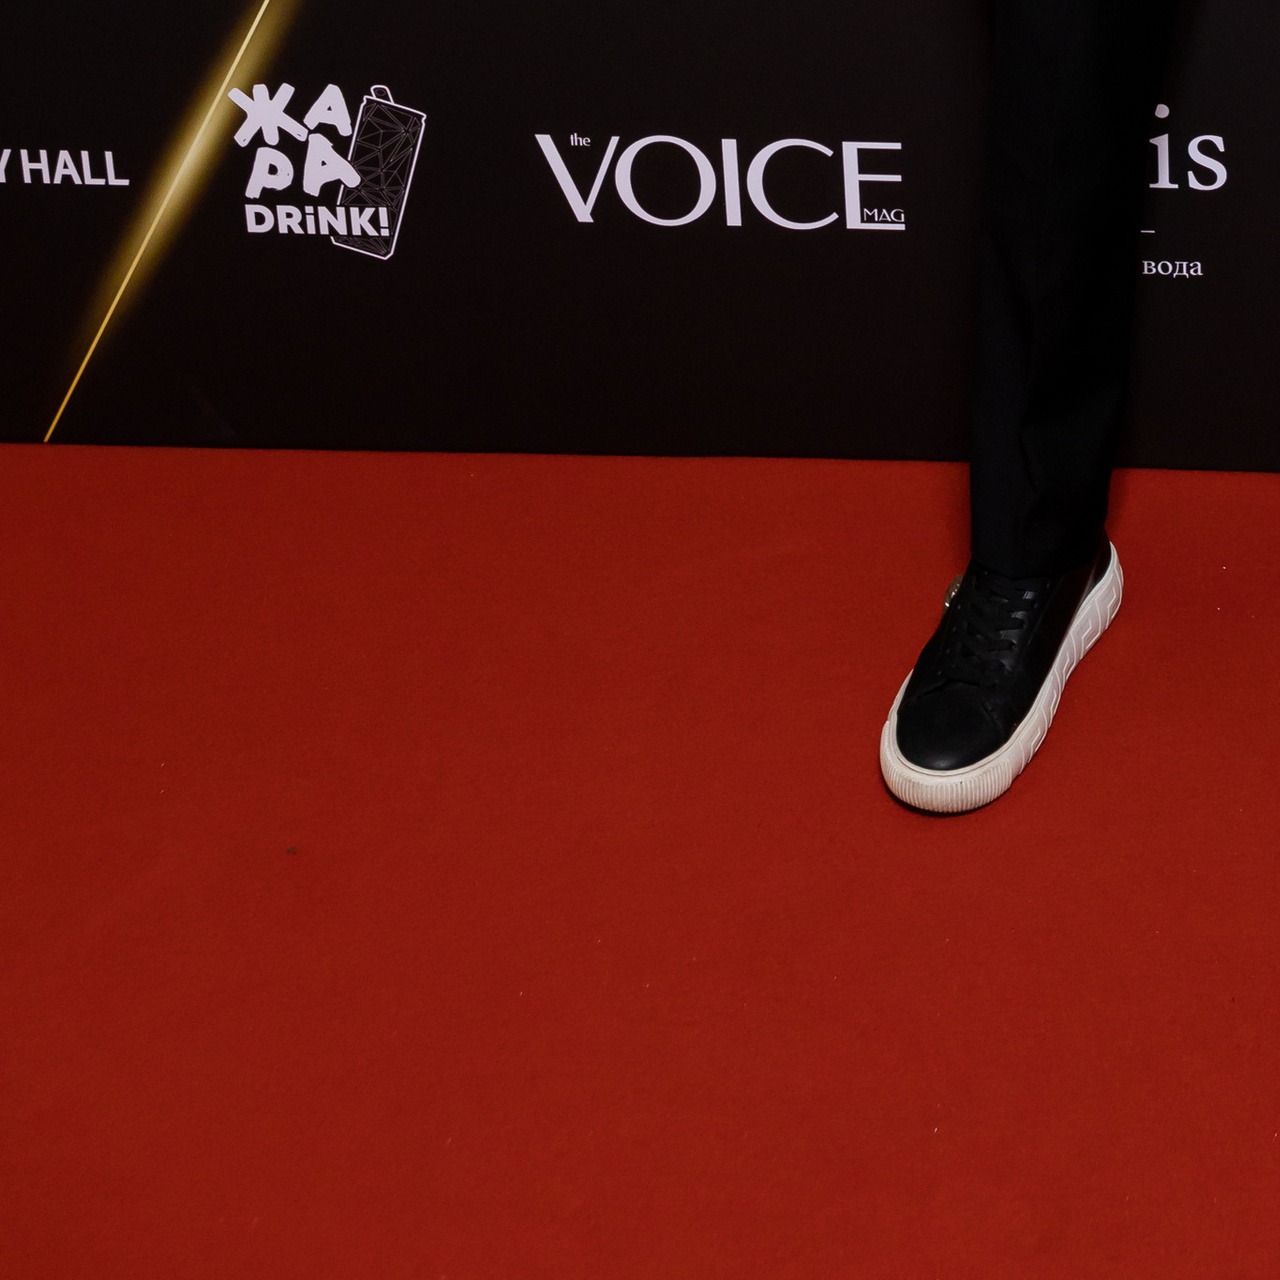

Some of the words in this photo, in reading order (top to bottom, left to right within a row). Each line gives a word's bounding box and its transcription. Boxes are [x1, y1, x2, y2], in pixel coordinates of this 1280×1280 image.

[570, 133, 592, 147] the
[20, 149, 130, 186] HALL
[535, 134, 905, 231] VOICE
[866, 209, 905, 224] MAG
[1142, 260, 1203, 278] вода
